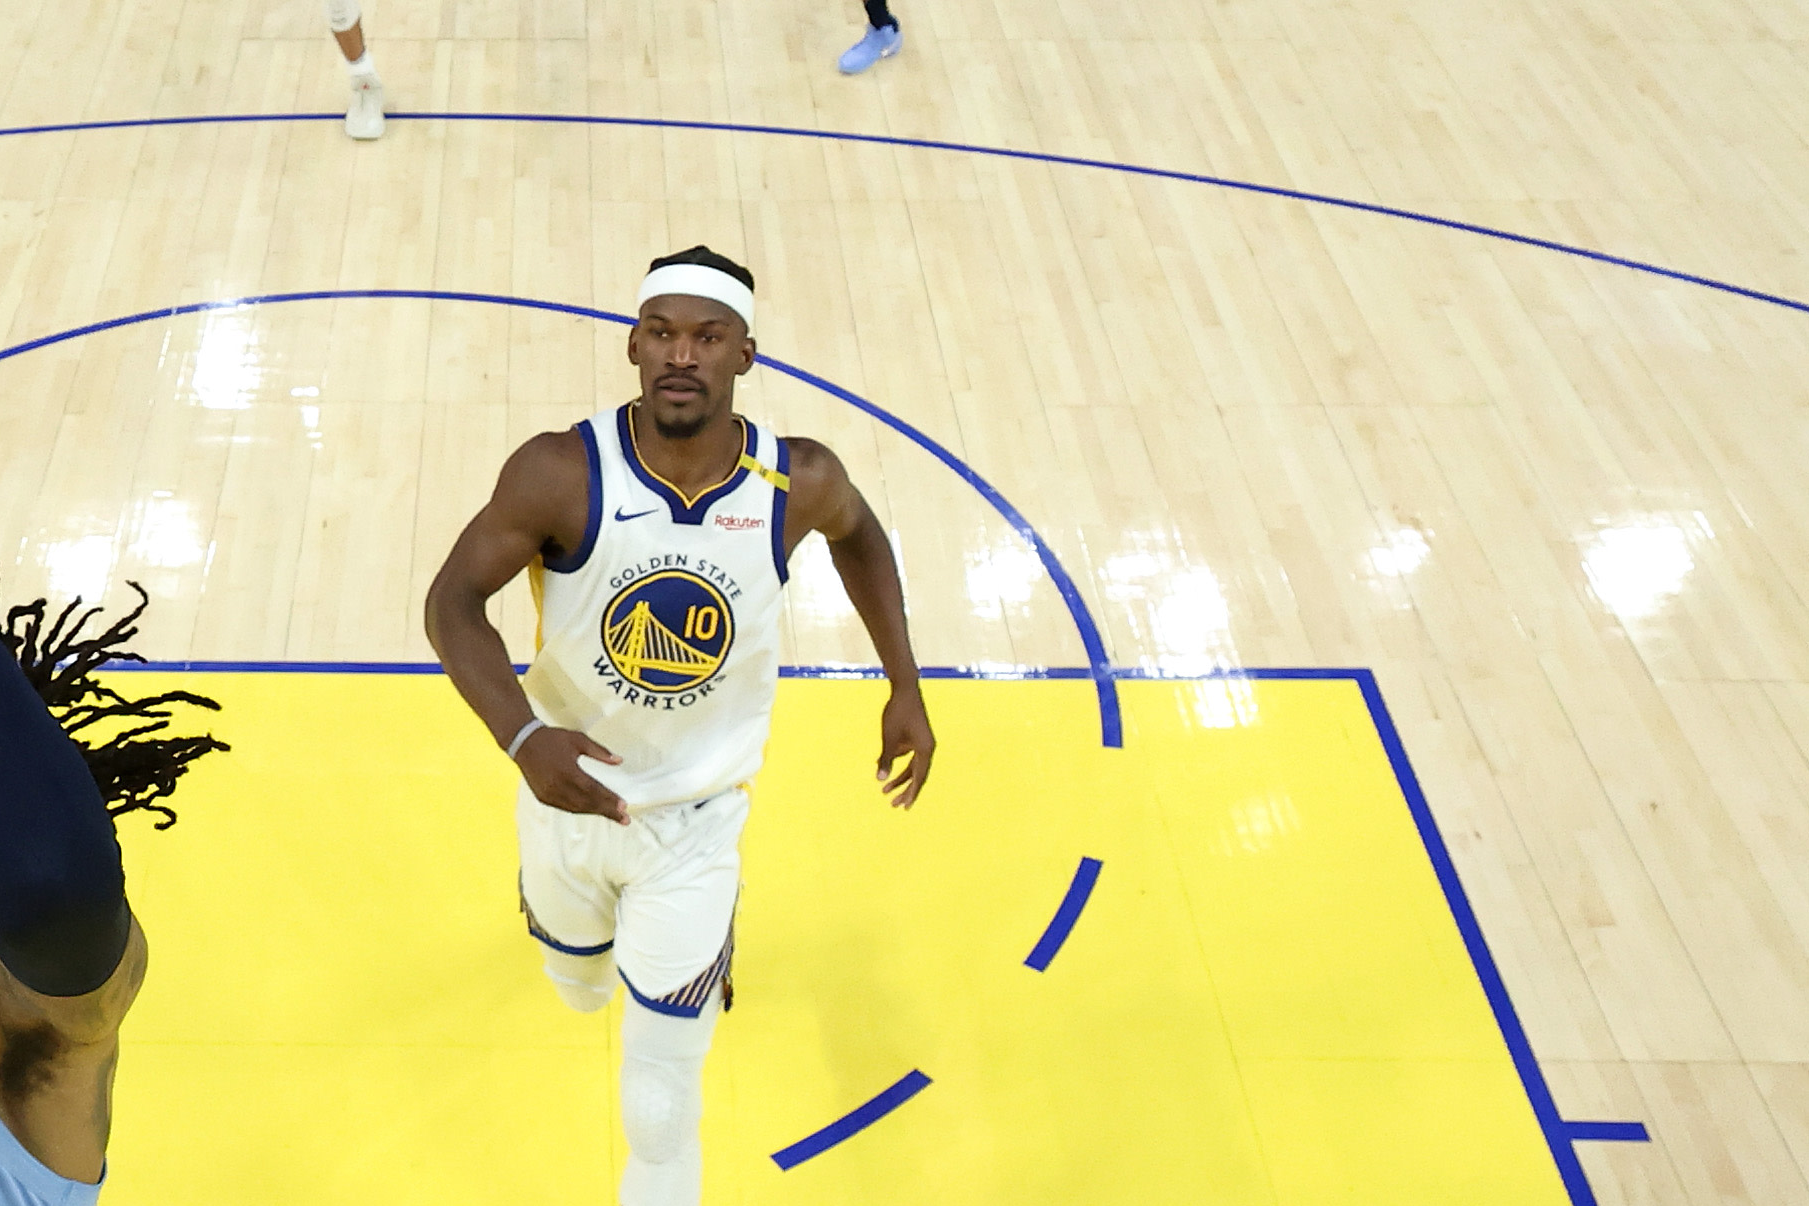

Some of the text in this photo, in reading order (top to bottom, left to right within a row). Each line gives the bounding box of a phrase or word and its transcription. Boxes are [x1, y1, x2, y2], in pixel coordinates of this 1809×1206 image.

[715, 515, 765, 529] Rakuten
[610, 554, 742, 600] GOLDEN STATE
[684, 604, 719, 641] 10
